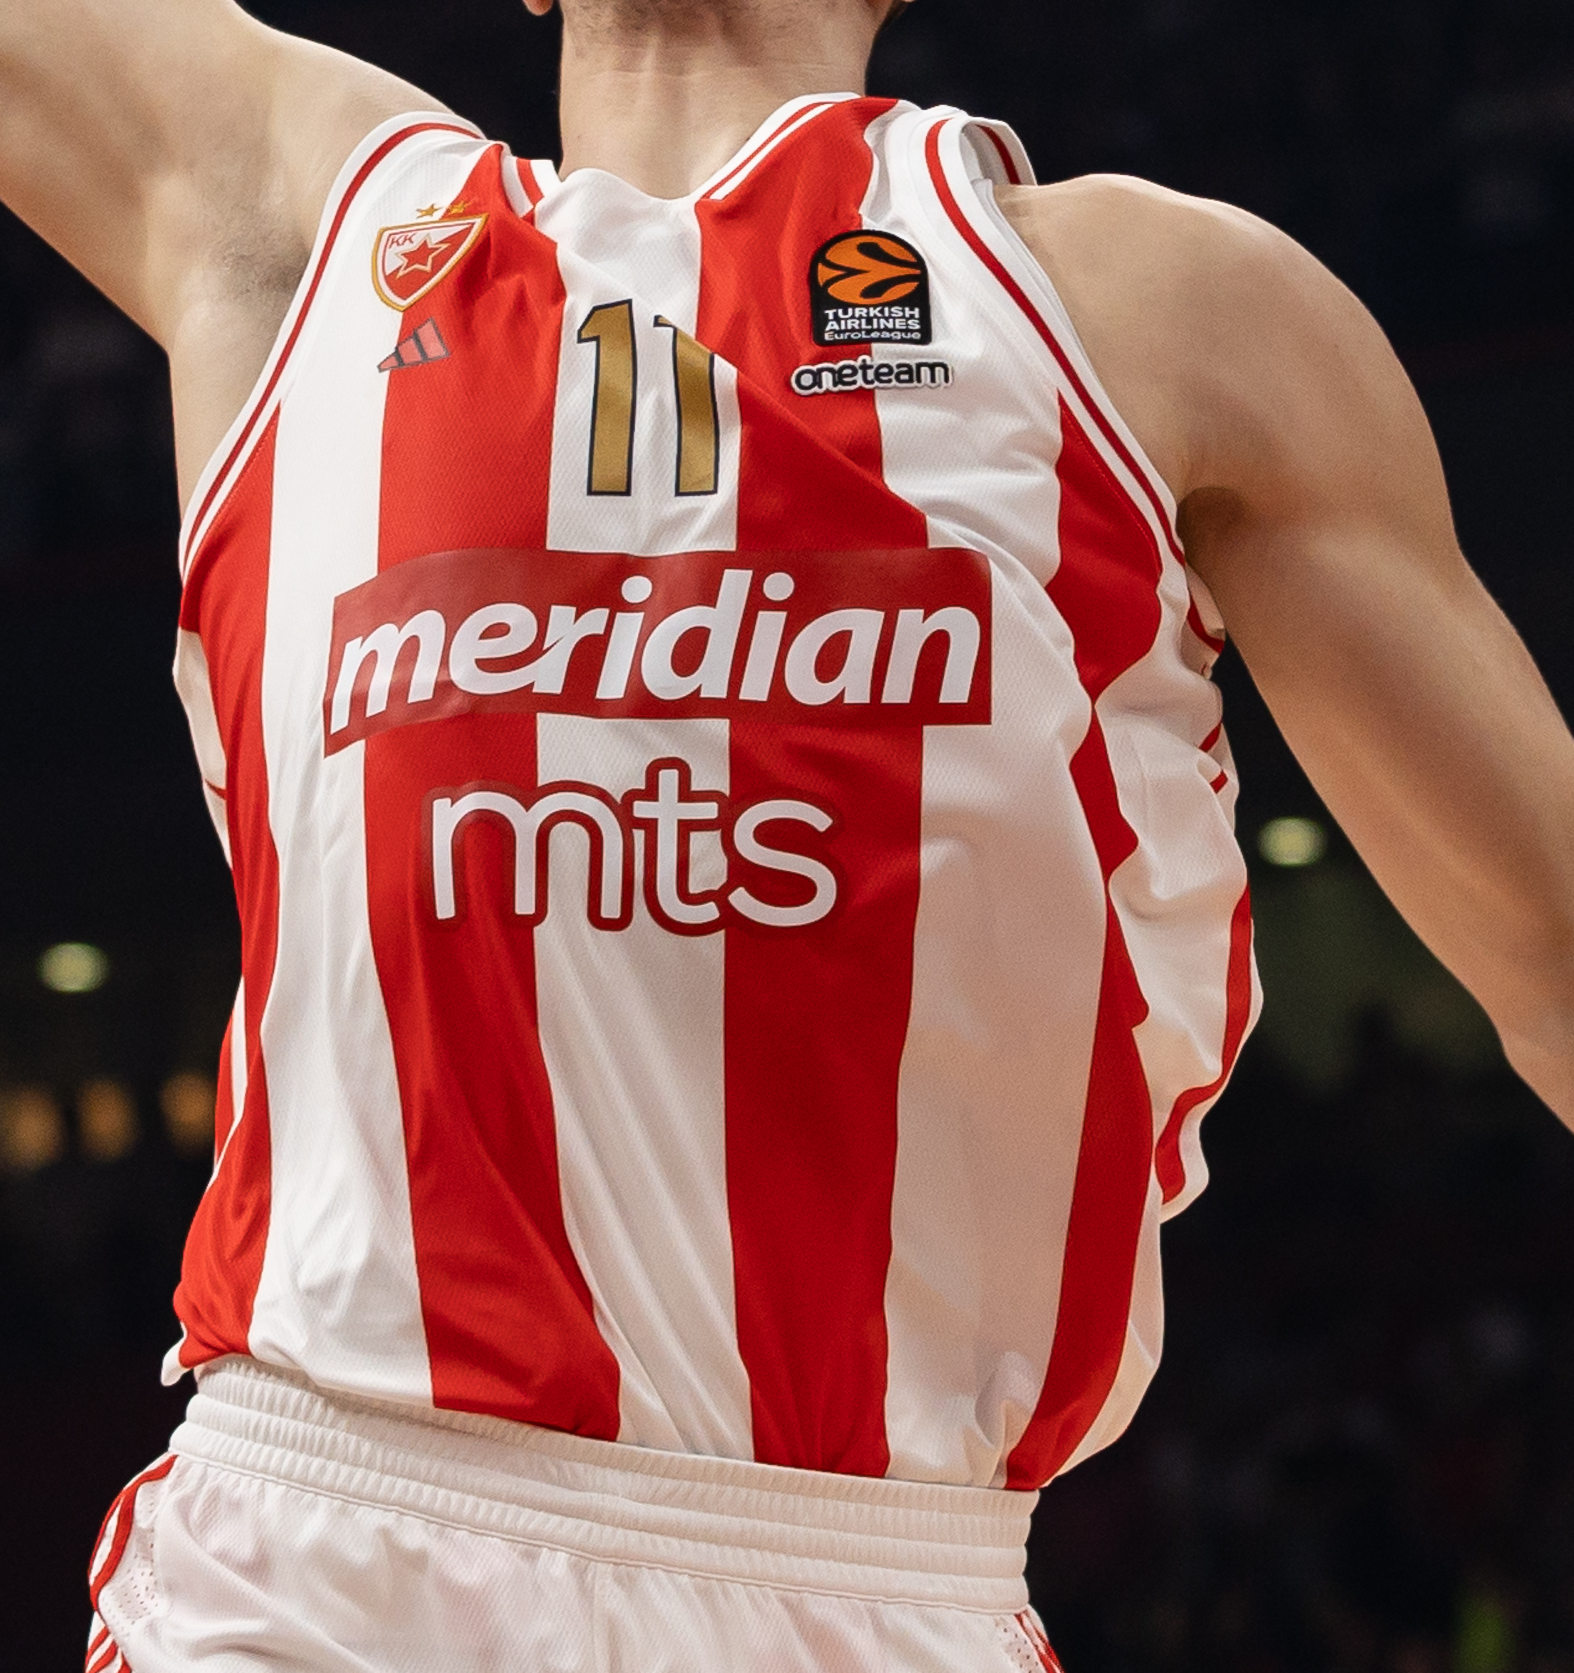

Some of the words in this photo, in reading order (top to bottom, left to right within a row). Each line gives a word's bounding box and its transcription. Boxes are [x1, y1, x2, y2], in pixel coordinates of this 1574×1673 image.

[388, 233, 416, 249] KK
[824, 306, 920, 320] TURKISH
[825, 318, 921, 331] AIRLINES
[824, 330, 921, 341] EuroLeague
[794, 358, 950, 390] oneteam
[576, 298, 720, 497] 11
[330, 568, 981, 735] meridian
[432, 769, 838, 926] mts
